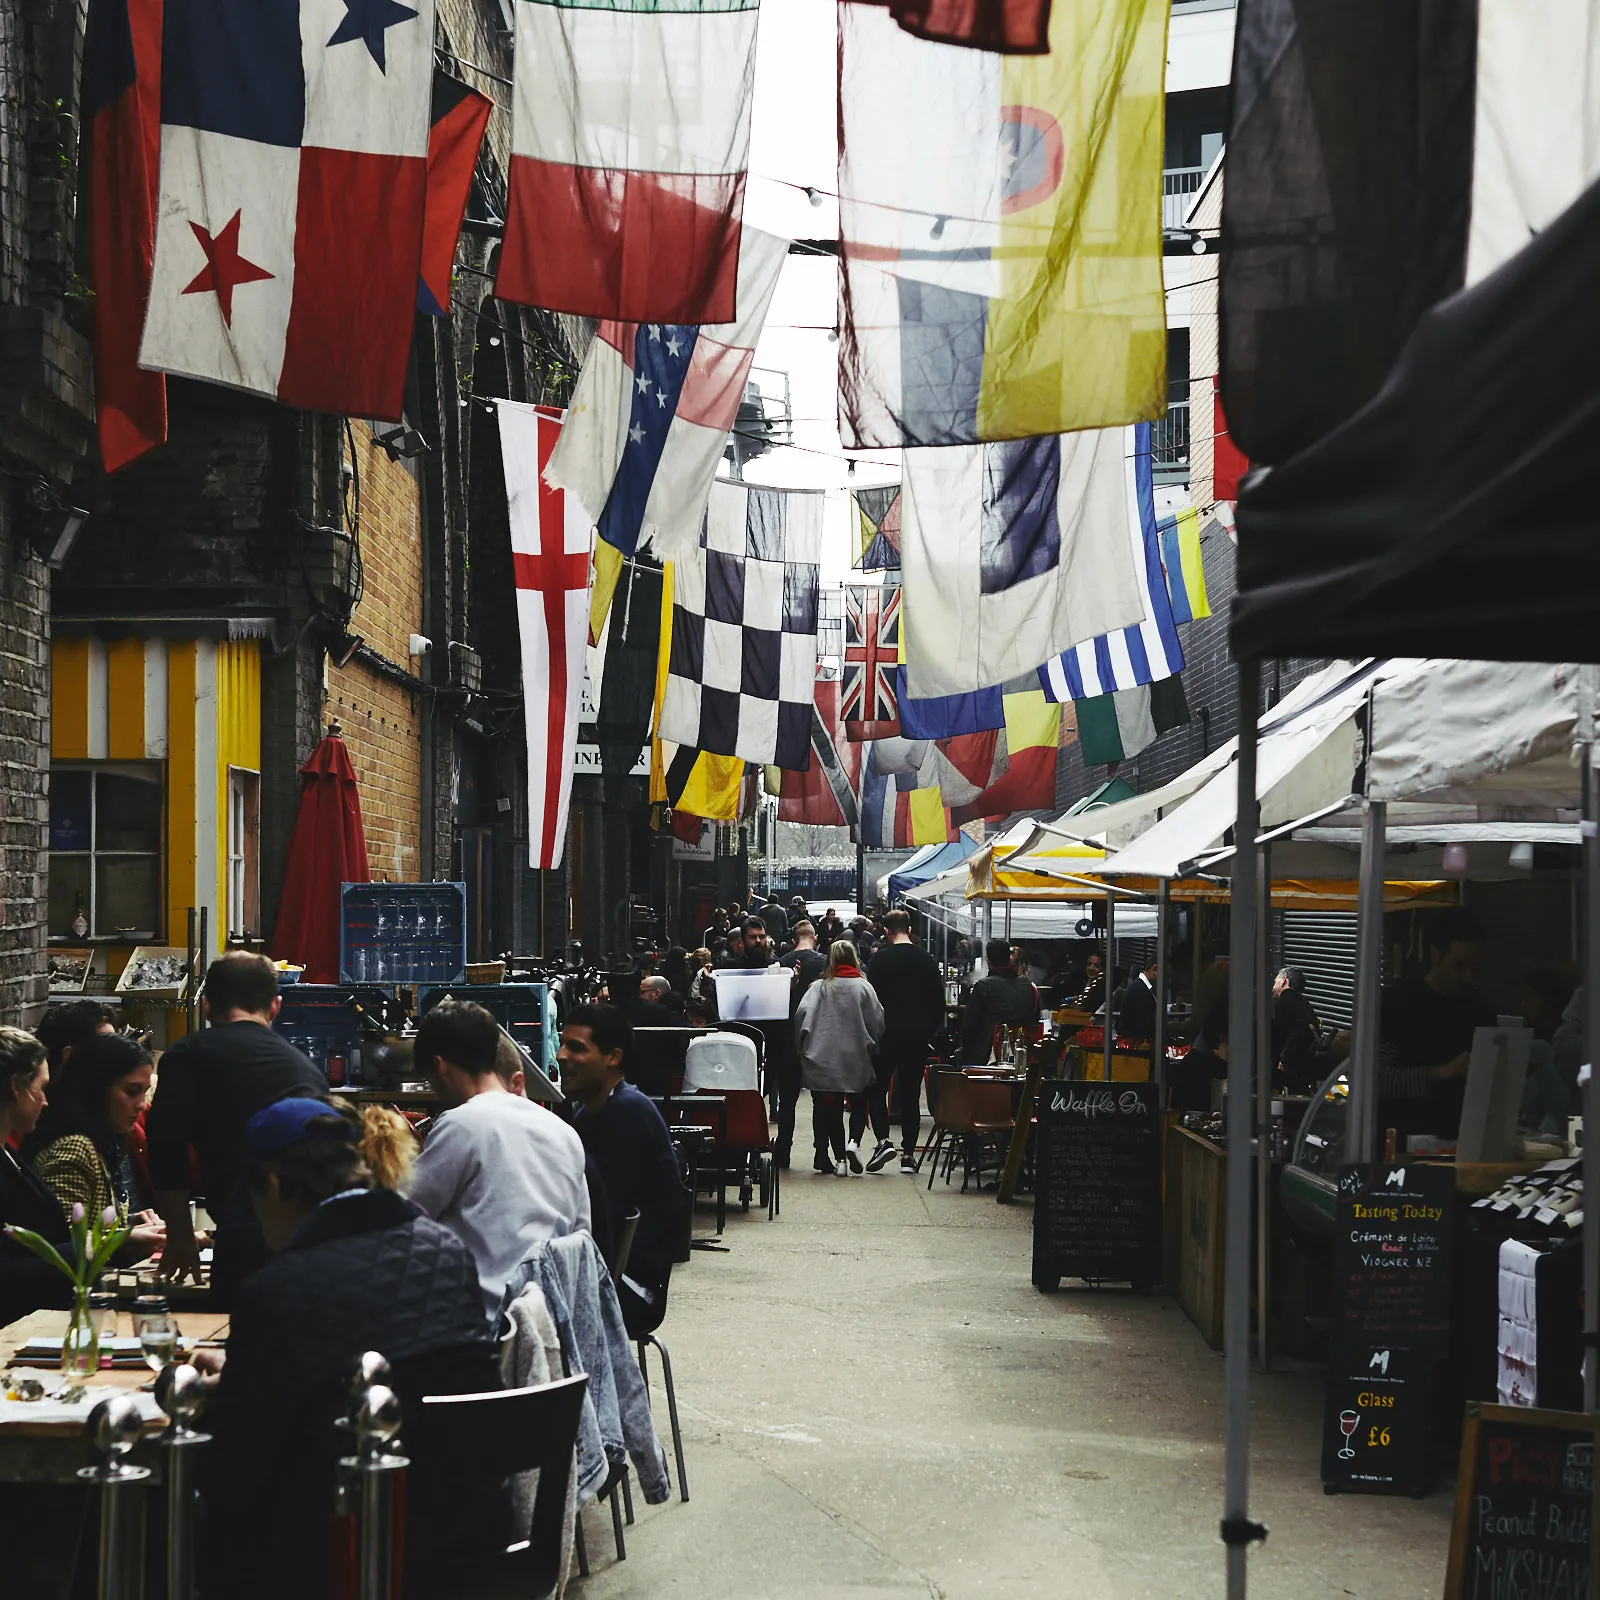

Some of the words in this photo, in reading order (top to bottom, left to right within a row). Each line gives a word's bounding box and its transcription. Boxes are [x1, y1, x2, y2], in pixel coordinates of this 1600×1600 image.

[1051, 1089, 1117, 1119] Waffle
[1119, 1090, 1149, 1116] On
[1352, 1203, 1399, 1222] Tasting
[1402, 1203, 1443, 1222] Today
[1350, 1230, 1393, 1243] Crémant
[1397, 1233, 1408, 1242] de
[1357, 1391, 1395, 1408] Glass
[1367, 1425, 1391, 1447] £6
[1476, 1494, 1538, 1539] Peanut
